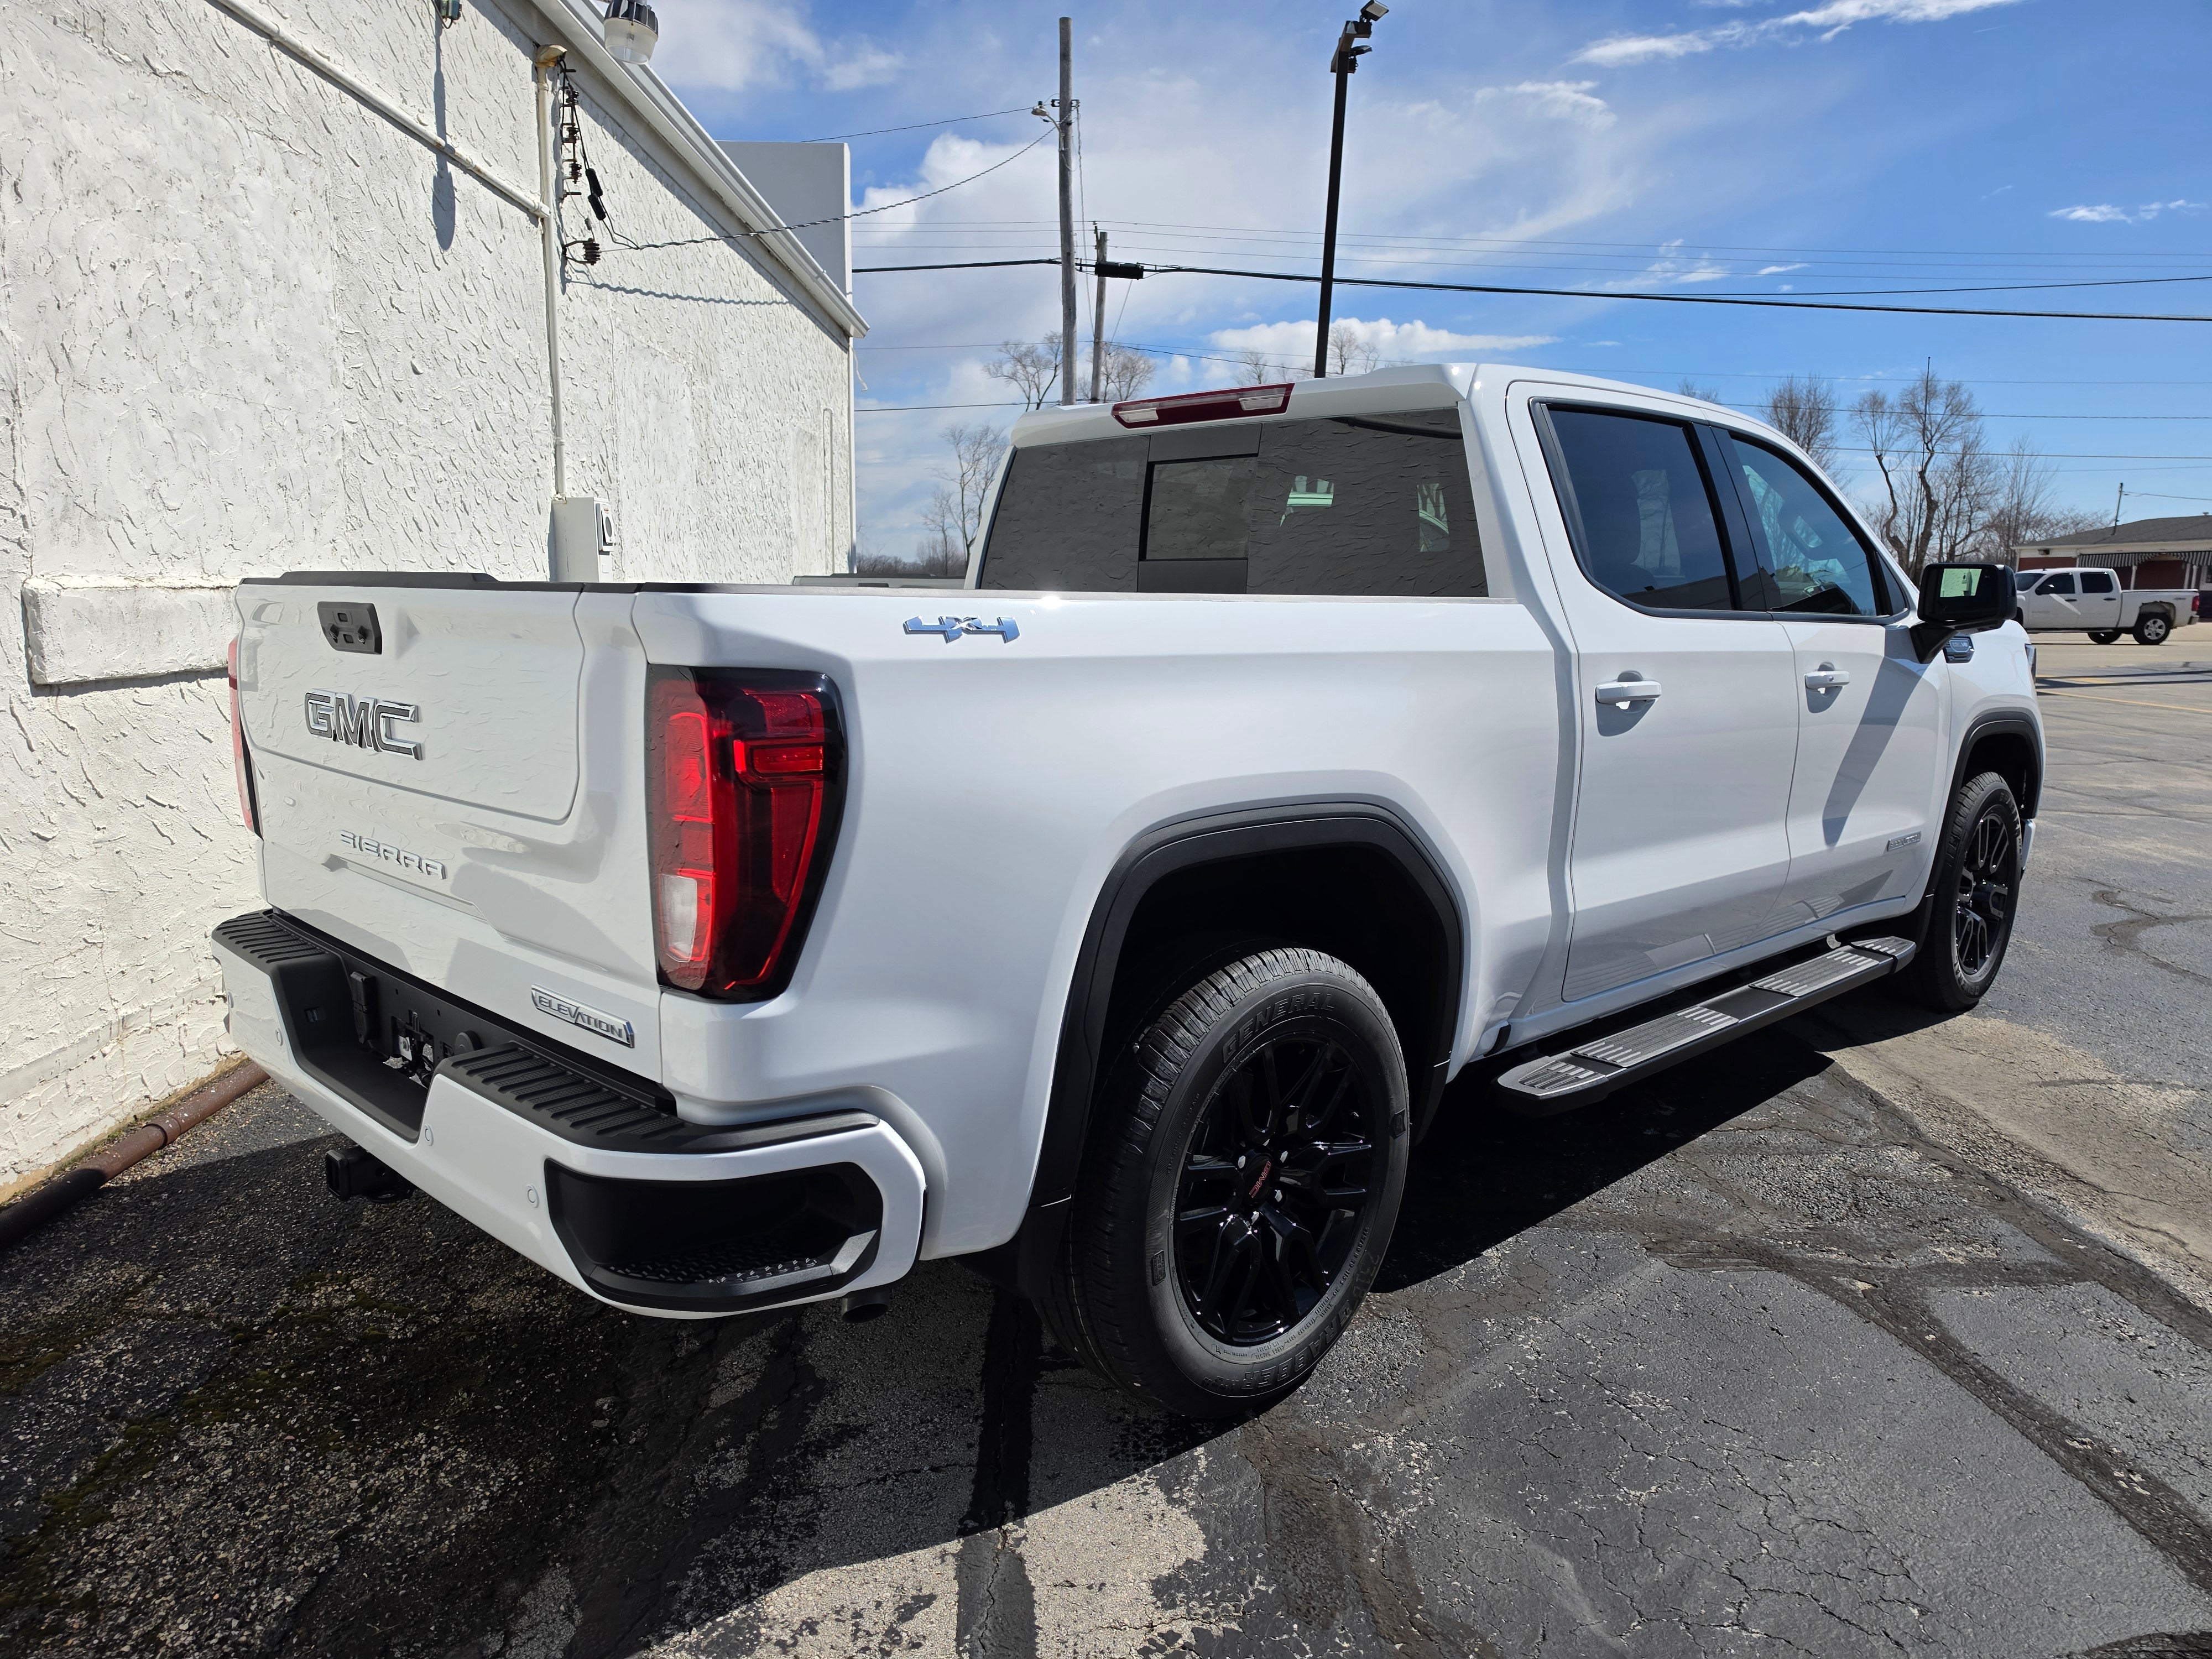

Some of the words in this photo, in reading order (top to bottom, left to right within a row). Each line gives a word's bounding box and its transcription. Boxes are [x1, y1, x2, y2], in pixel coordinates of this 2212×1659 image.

[305, 689, 425, 761] GMC
[340, 830, 447, 880] SIERRA
[538, 995, 623, 1039] ELEVATION
[1223, 993, 1335, 1063] GENERAL
[1249, 1161, 1272, 1198] GMC
[1240, 1300, 1353, 1390] GRABBER
